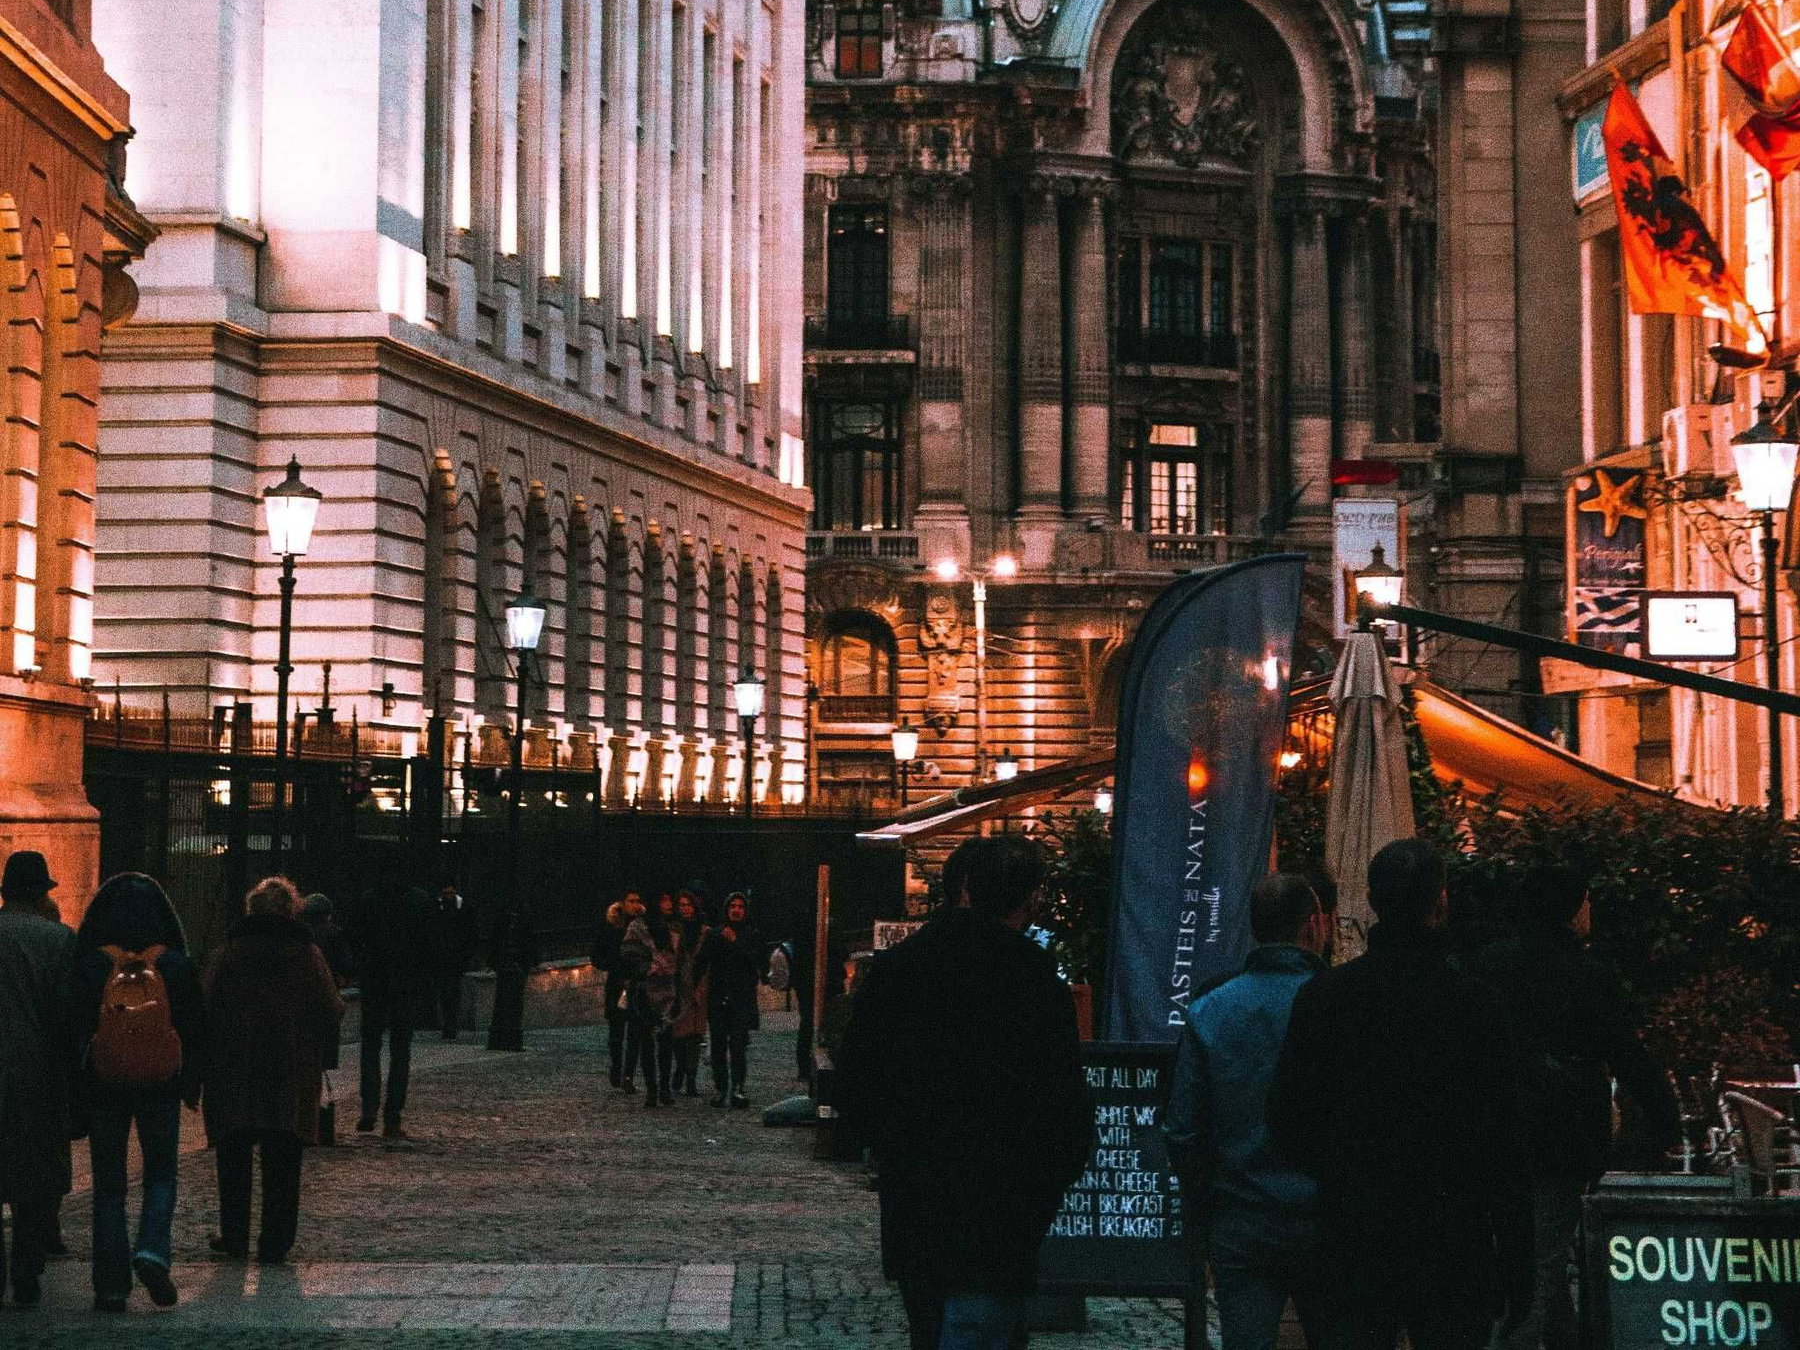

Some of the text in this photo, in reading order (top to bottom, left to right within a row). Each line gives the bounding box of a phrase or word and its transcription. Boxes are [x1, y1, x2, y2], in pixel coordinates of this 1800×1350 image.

[1168, 910, 1196, 1026] PASTEIS
[1185, 800, 1208, 880] NATA
[1203, 887, 1221, 943] by vanilla
[1083, 1066, 1159, 1088] AST ALL DAY
[1095, 1105, 1157, 1125] SIMPLE WAY
[1098, 1127, 1130, 1146] WITH
[1096, 1149, 1141, 1170] CHEESE
[1100, 1171, 1110, 1189] &
[1115, 1171, 1160, 1193] CHEESE
[1099, 1194, 1165, 1214] BREAKFAST
[1046, 1215, 1093, 1236] NGLISH
[1099, 1217, 1166, 1238] BREAKFAST
[1661, 1300, 1772, 1347] SHOP
